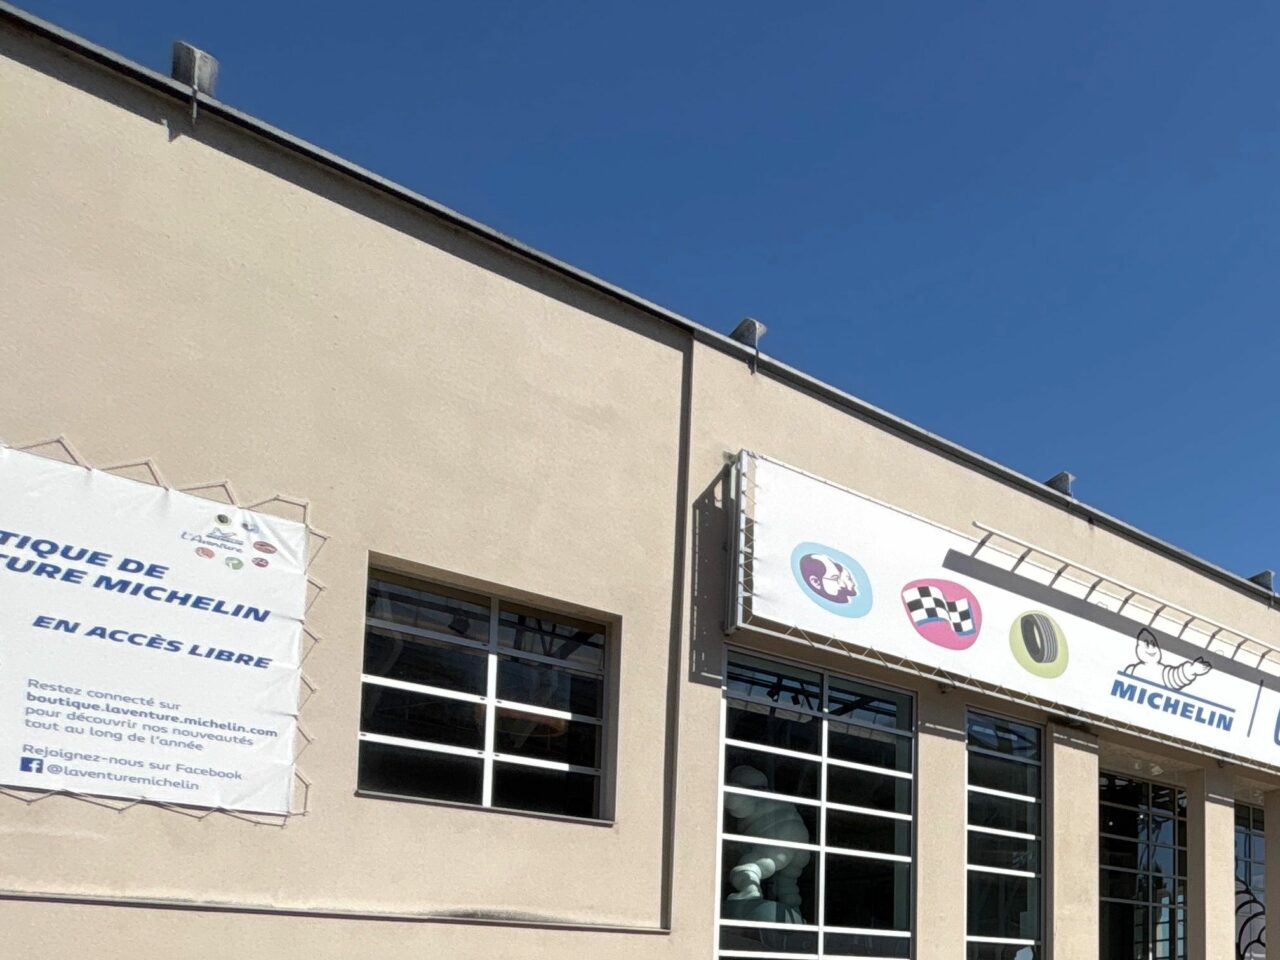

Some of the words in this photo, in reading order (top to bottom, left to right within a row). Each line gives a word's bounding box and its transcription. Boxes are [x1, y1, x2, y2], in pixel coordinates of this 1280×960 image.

[0, 530, 112, 567] TIQUE
[117, 558, 169, 579] DE
[181, 531, 243, 553] L'Aventure
[0, 553, 88, 584] URE
[93, 575, 271, 622] MICHELIN
[32, 615, 81, 634] EN
[84, 626, 184, 652] ACCÈS
[188, 644, 273, 669] LIBRE
[26, 691, 278, 738] boutique.laventure.michelin.com
[27, 679, 82, 695] Restez
[86, 689, 155, 706] connecté
[159, 701, 181, 710] sur
[1110, 680, 1234, 731] MICHELIN
[25, 706, 62, 718] pour
[66, 711, 137, 729] découvrir
[142, 723, 168, 733] nos
[172, 728, 254, 746] nouveautés
[25, 719, 60, 731] tout
[64, 725, 84, 734] au
[90, 726, 122, 741] long
[127, 732, 146, 743] de
[150, 735, 204, 751] l'année
[22, 744, 144, 767] Rejoignez-nous
[149, 761, 171, 770] sur
[176, 763, 242, 780] Facebook
[47, 764, 199, 790] @laventuremichelin
